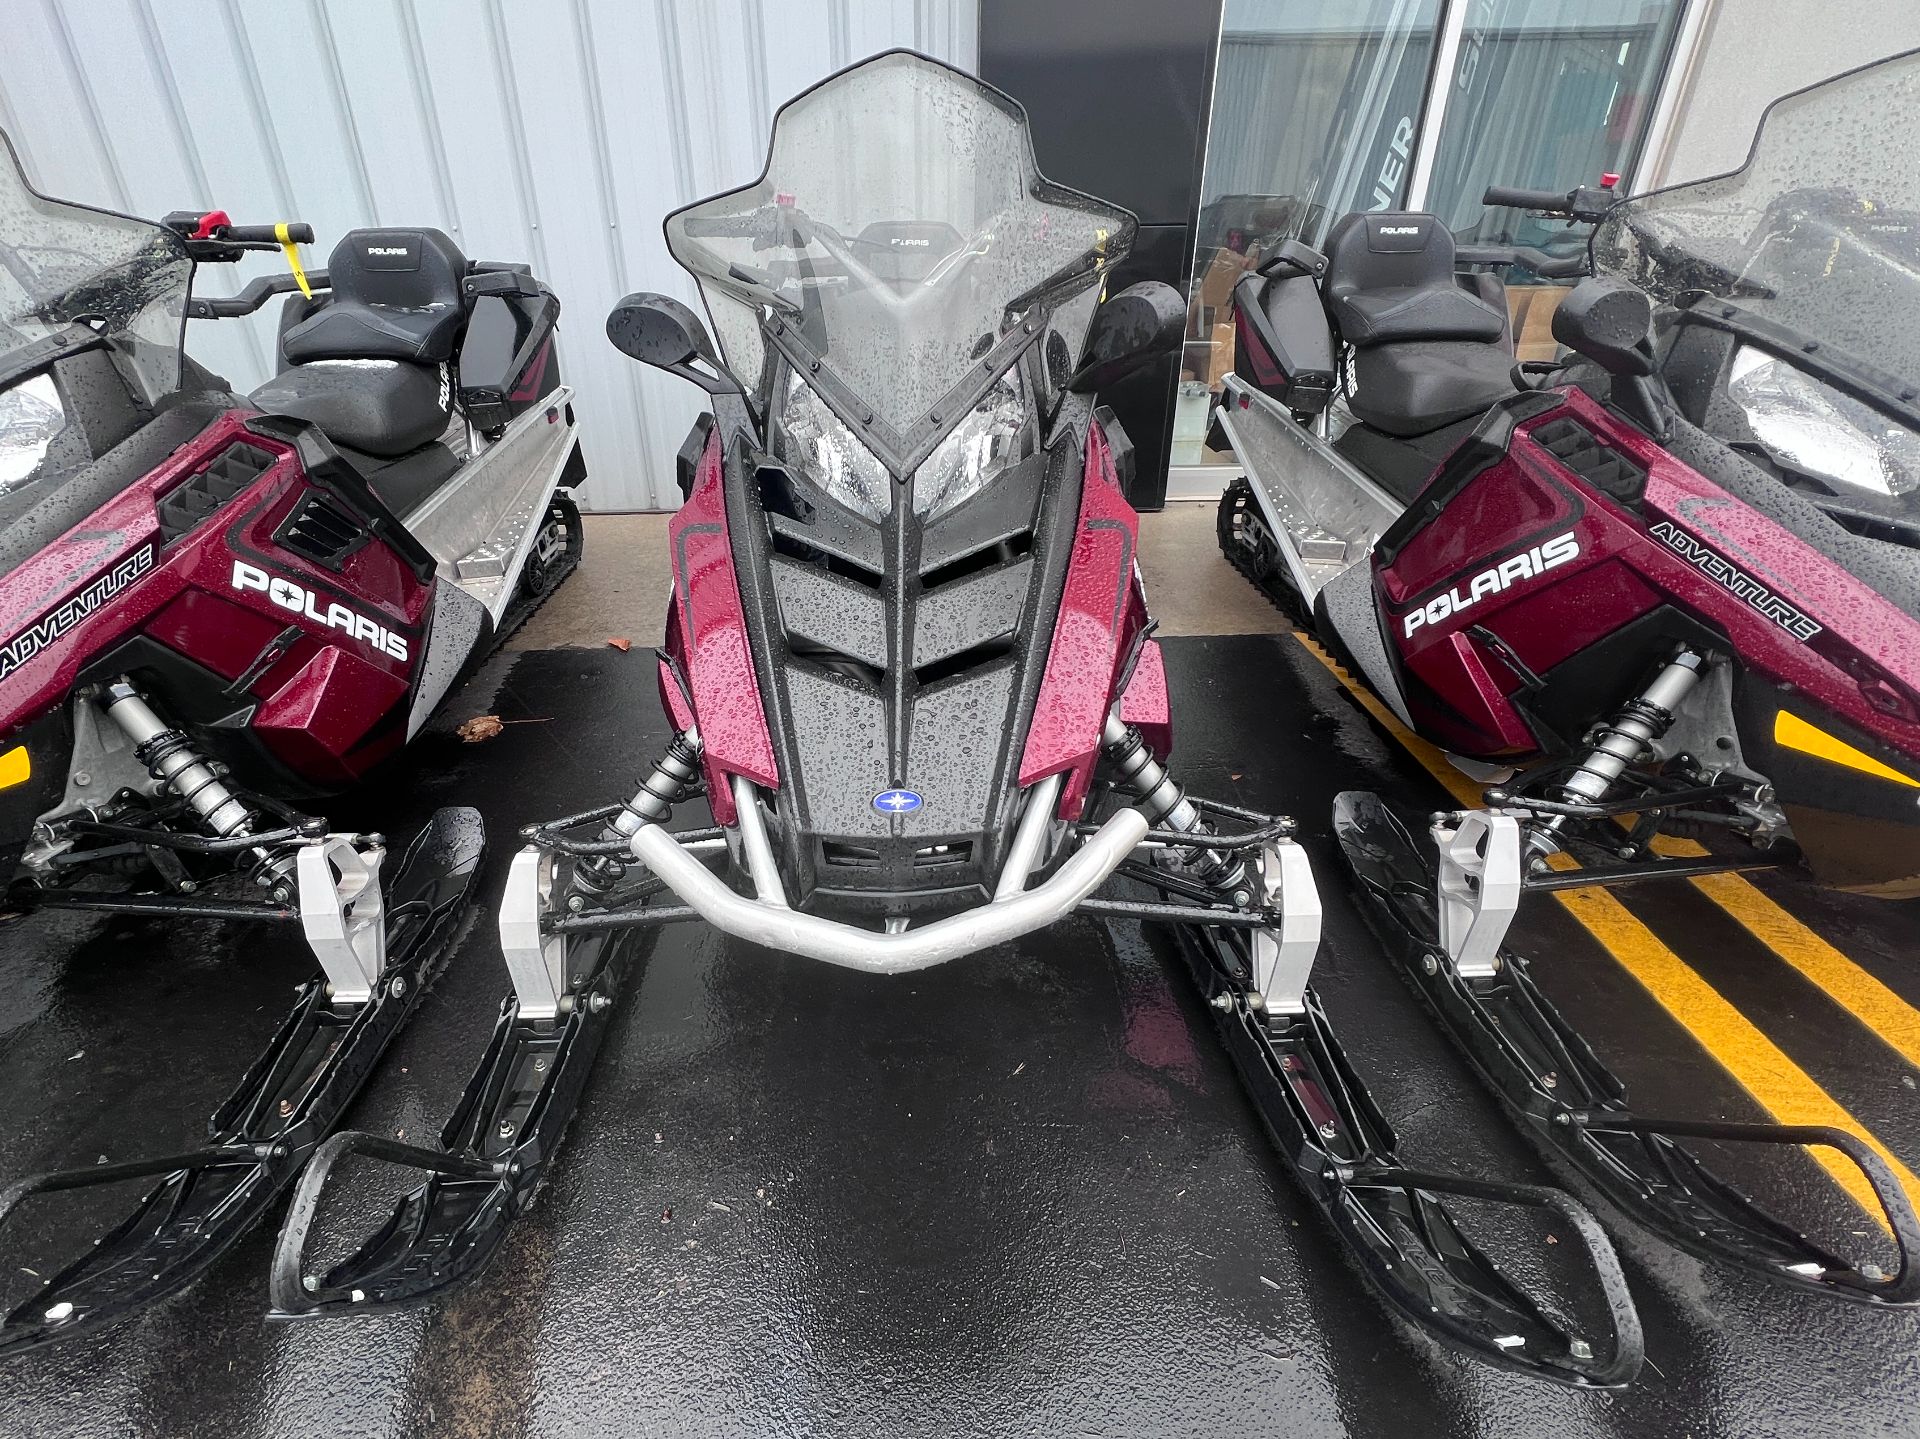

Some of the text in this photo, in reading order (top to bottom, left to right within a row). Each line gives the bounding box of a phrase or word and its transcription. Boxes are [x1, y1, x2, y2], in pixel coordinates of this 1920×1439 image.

[367, 247, 408, 255] POLARIS
[1380, 226, 1419, 234] POLARIS
[1342, 340, 1359, 398] OLARIS
[0, 543, 153, 680] ADVENTURE
[231, 559, 408, 662] POLARIS
[1404, 531, 1580, 639] POLARIS
[1649, 521, 1823, 641] ADVENTURE
